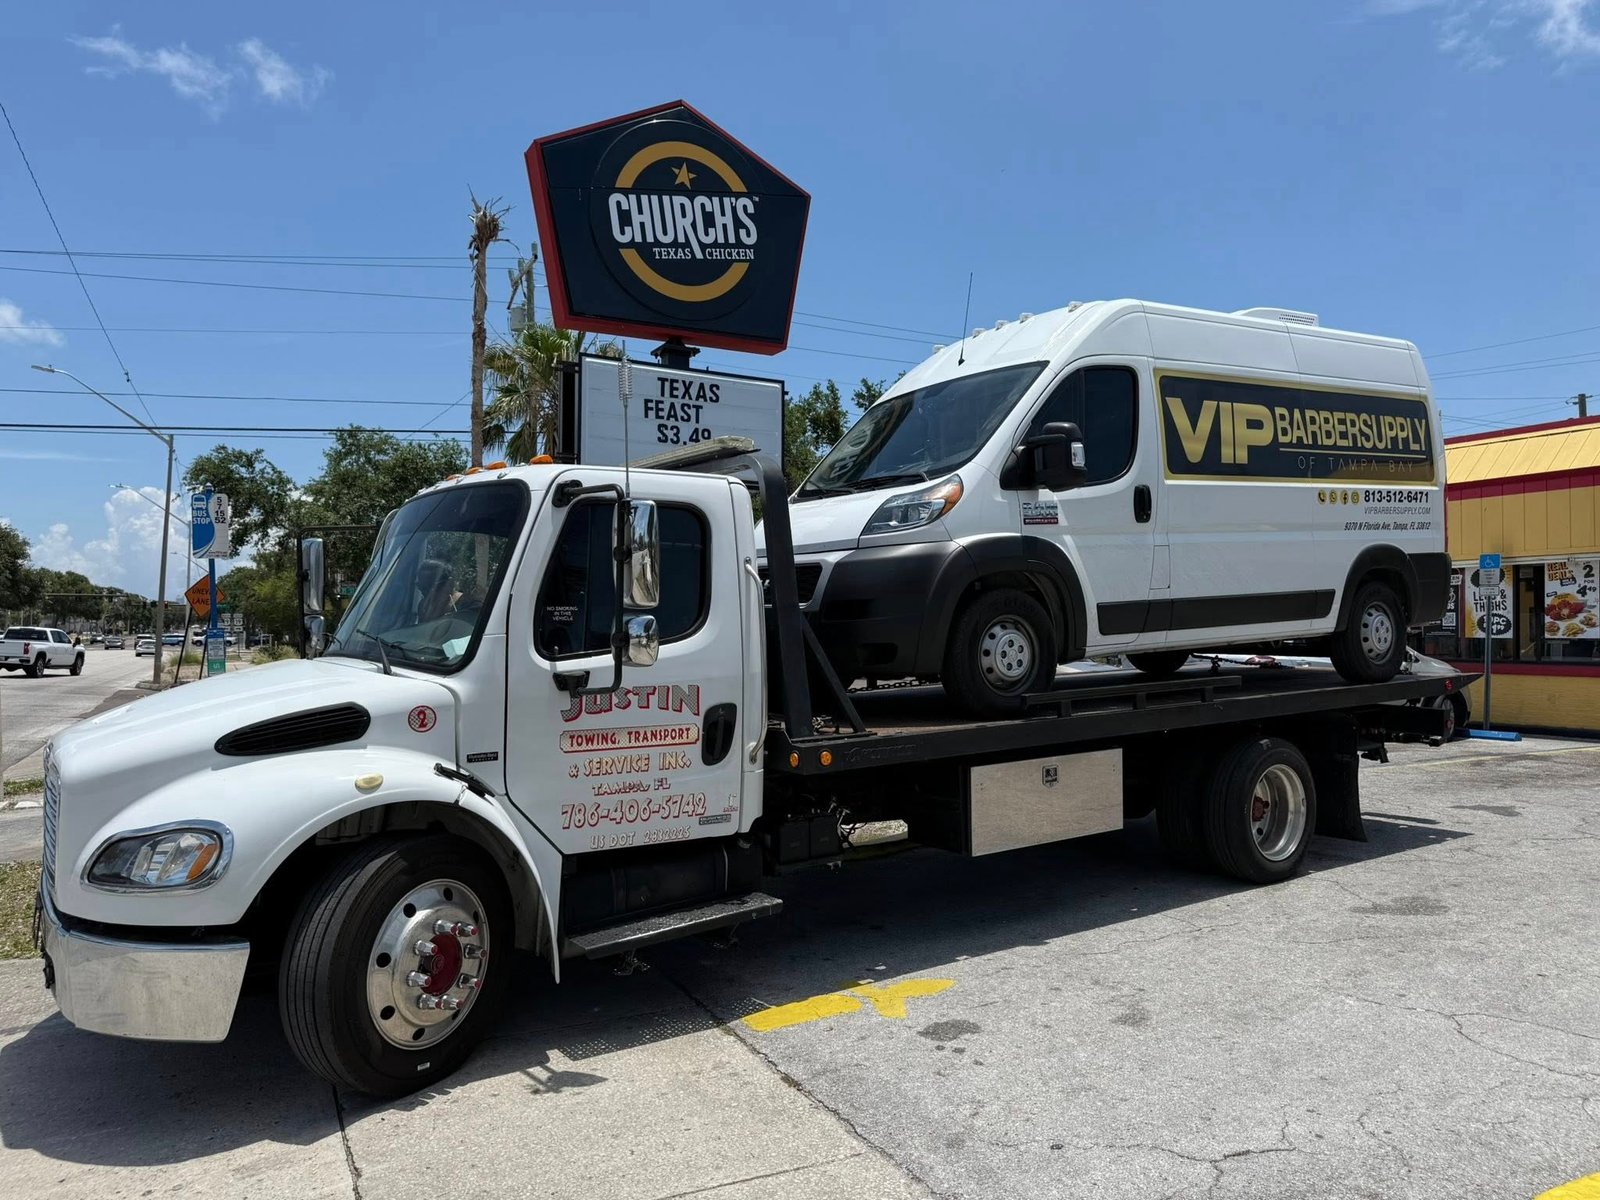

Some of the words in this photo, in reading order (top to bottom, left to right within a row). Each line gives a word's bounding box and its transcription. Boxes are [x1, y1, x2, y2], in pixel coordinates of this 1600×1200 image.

[608, 192, 758, 259] CHURCH'S
[653, 247, 692, 259] TEXAS
[705, 249, 755, 260] CHICKEN
[657, 377, 720, 403] TEXAS
[643, 399, 703, 424] FEAST
[1165, 396, 1275, 464] VIP
[1274, 406, 1426, 450] BARBERSUPPLY
[1297, 455, 1316, 470] OF
[1328, 457, 1379, 472] TAMPA
[1389, 459, 1414, 473] BAY
[216, 496, 223, 504] 5
[217, 503, 223, 511] 7
[192, 517, 211, 526] STOP
[214, 517, 227, 525] 52
[1363, 521, 1381, 531] Florida
[1582, 564, 1595, 579] 2
[560, 684, 700, 722] JUSTIN
[627, 727, 692, 744] TRANSPORT
[568, 764, 580, 778] &
[583, 753, 650, 777] SERVICE
[659, 750, 692, 771] INC.
[654, 777, 671, 790] FL
[561, 792, 707, 830] 786-406-5742
[590, 835, 605, 849] US
[609, 831, 635, 847] DOT
